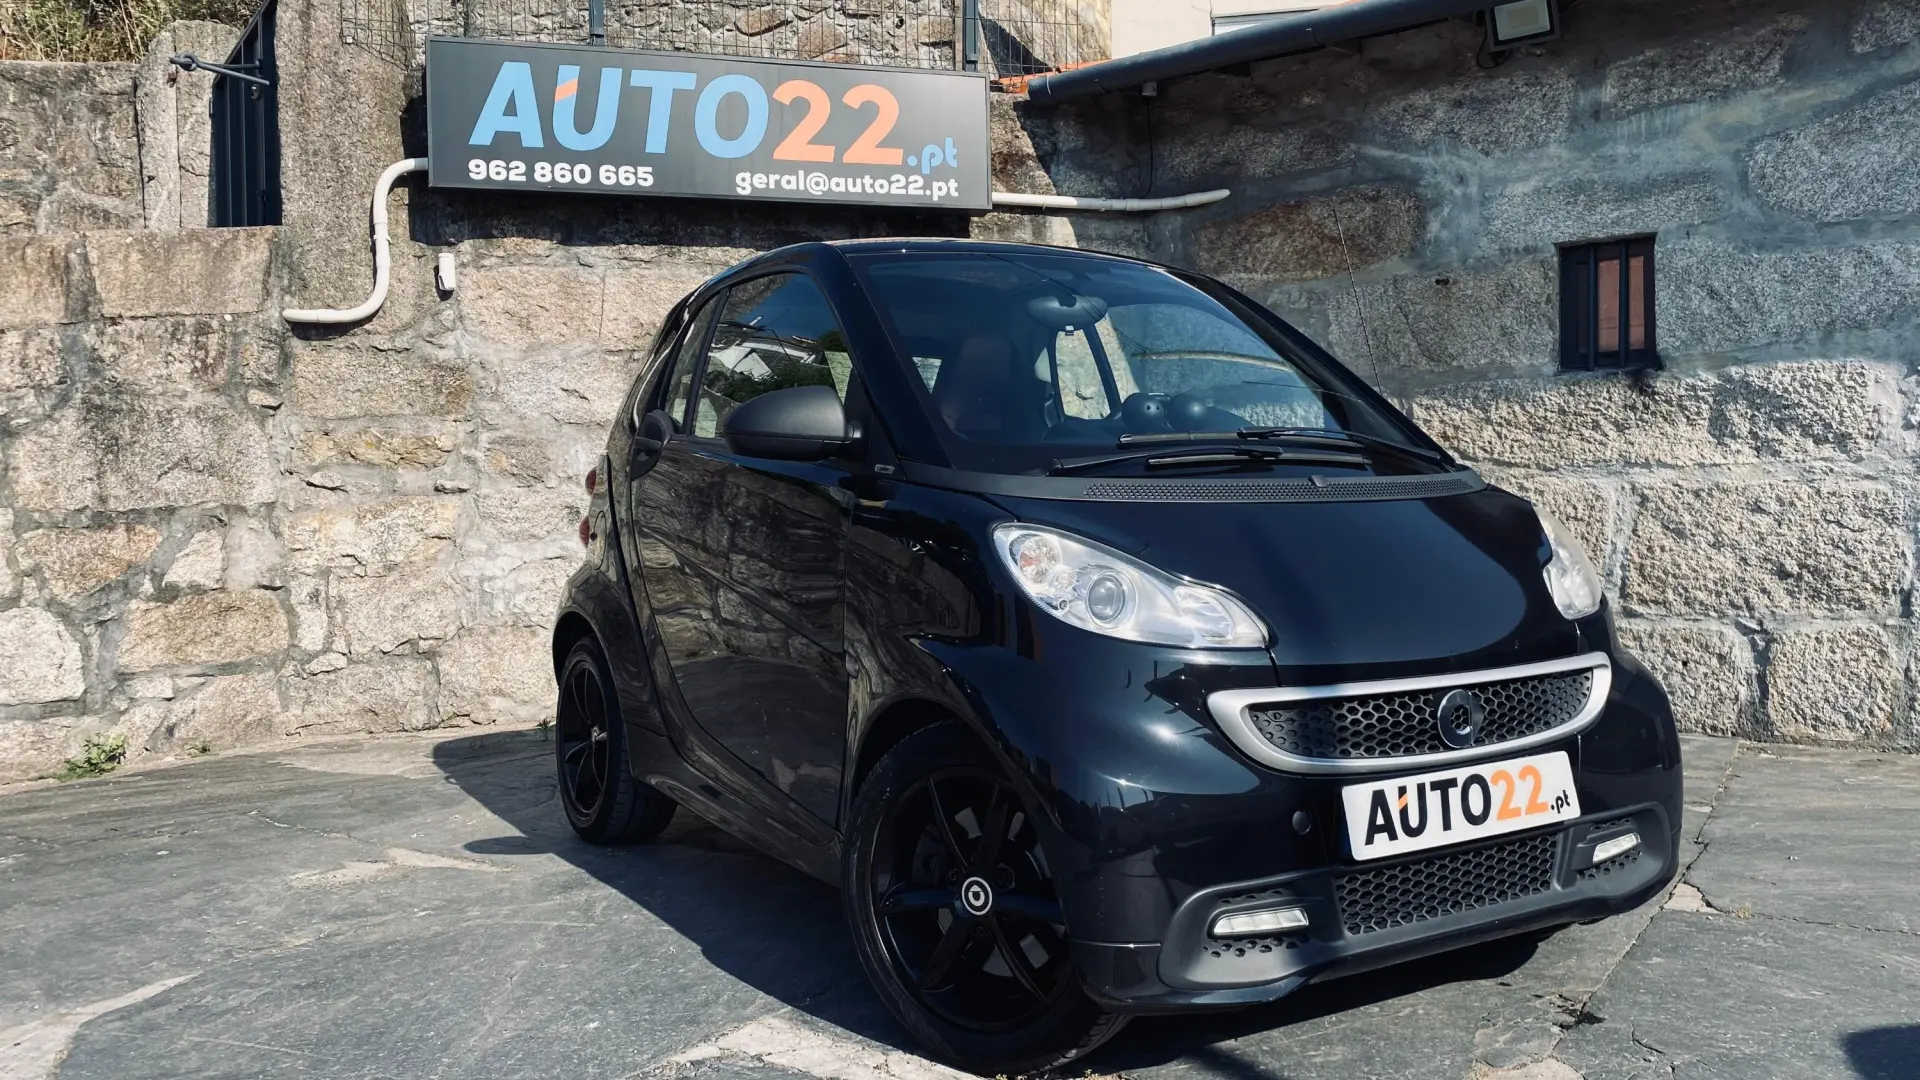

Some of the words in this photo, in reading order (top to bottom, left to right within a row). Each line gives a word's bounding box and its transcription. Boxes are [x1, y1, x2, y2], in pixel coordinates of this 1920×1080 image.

[468, 61, 958, 174] AUTO22.pt
[468, 159, 527, 181] 962
[533, 161, 593, 184] 860
[599, 164, 654, 187] 665
[735, 170, 959, 201] geral@auto22.pt
[1365, 765, 1570, 846] AUTO22.pt
